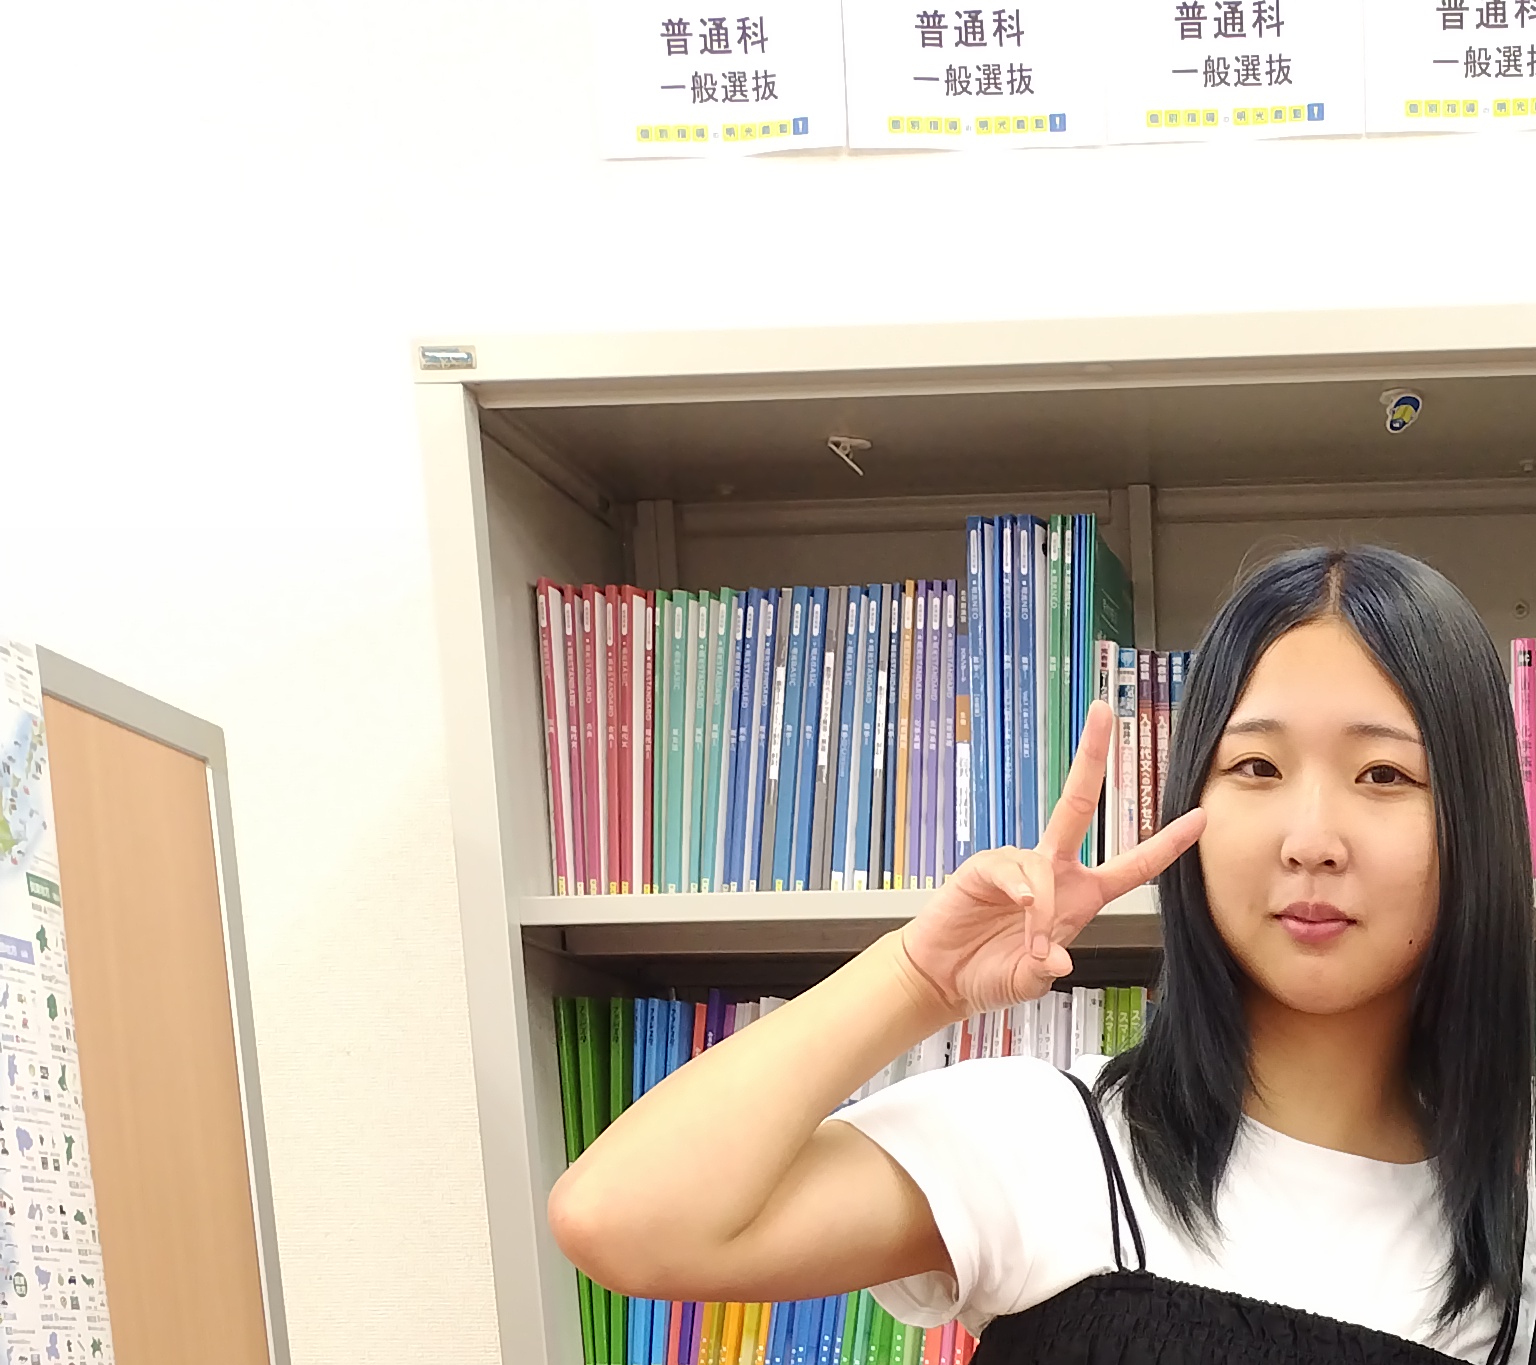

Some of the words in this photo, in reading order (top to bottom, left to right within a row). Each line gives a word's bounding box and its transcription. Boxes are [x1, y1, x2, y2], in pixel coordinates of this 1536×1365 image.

[660, 16, 769, 56] 普通科
[915, 9, 1024, 49] 普通科
[1174, 1, 1286, 40] 普通科
[660, 70, 780, 103] 一般選抜
[913, 63, 1034, 97] 一般選抜
[1172, 53, 1293, 88] 一般選抜
